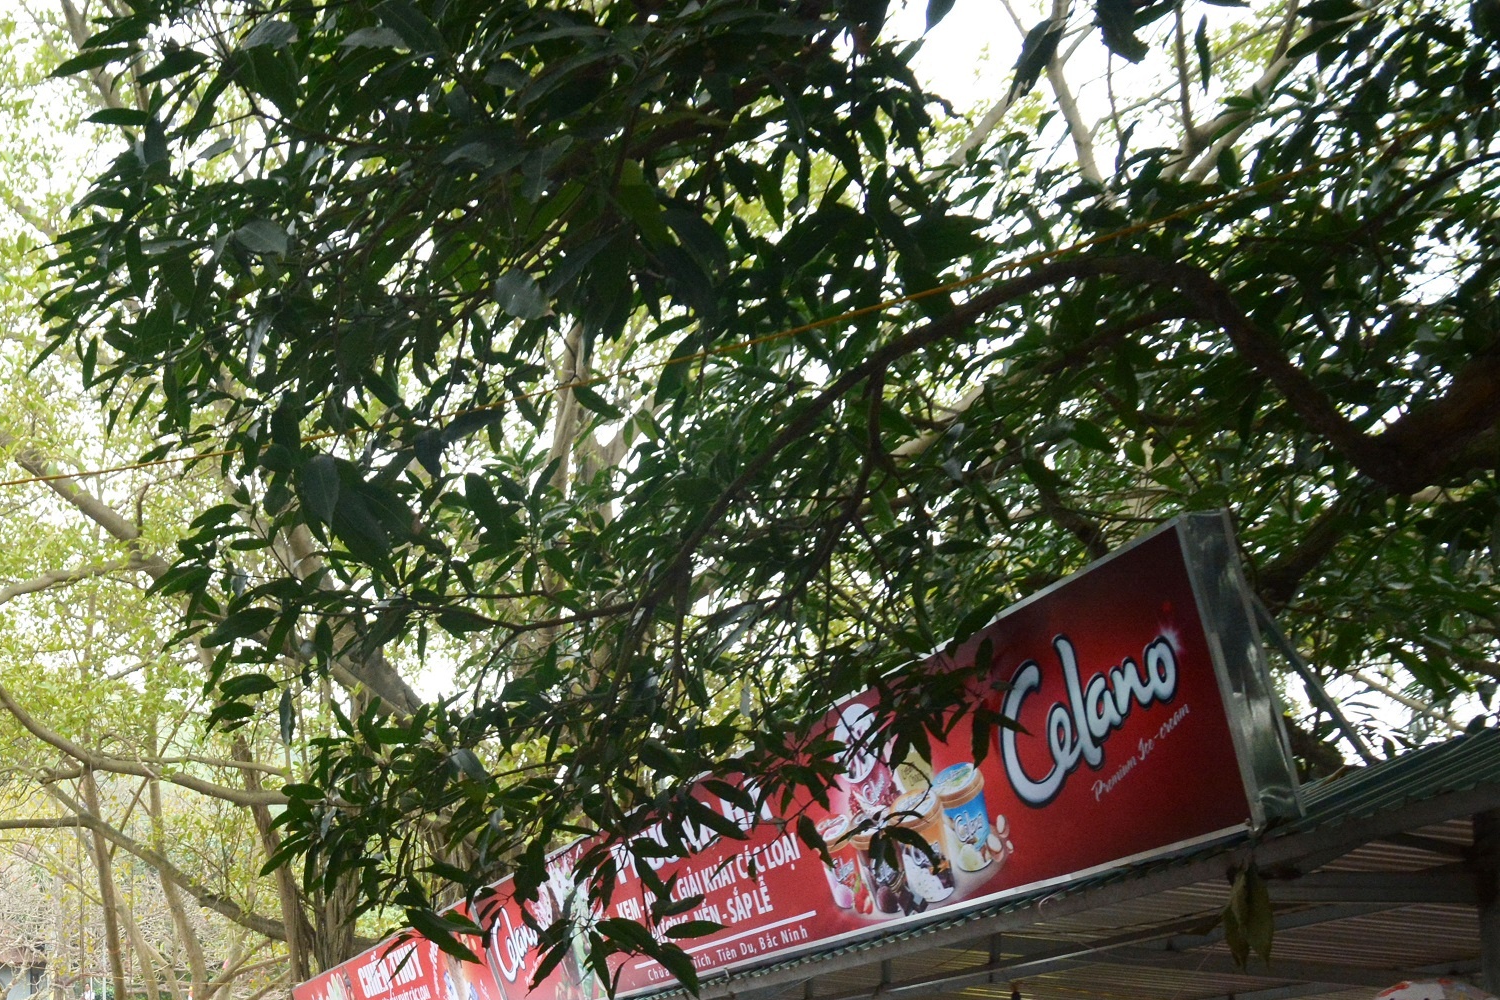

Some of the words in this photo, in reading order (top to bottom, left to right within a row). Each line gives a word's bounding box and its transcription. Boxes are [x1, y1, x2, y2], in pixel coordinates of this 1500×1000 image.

[1001, 634, 1177, 808] Celano
[616, 896, 642, 920] KEM
[677, 866, 704, 900] GIẢI
[701, 855, 736, 893] KHÁT
[763, 833, 801, 876] LOẠI
[726, 886, 753, 924] SẮP
[753, 875, 774, 915] LỄ
[648, 967, 671, 982] Chùa
[717, 947, 737, 963] Tiên
[739, 942, 757, 955] Du,
[759, 933, 778, 950] Bắc
[781, 925, 808, 944] Ninh
